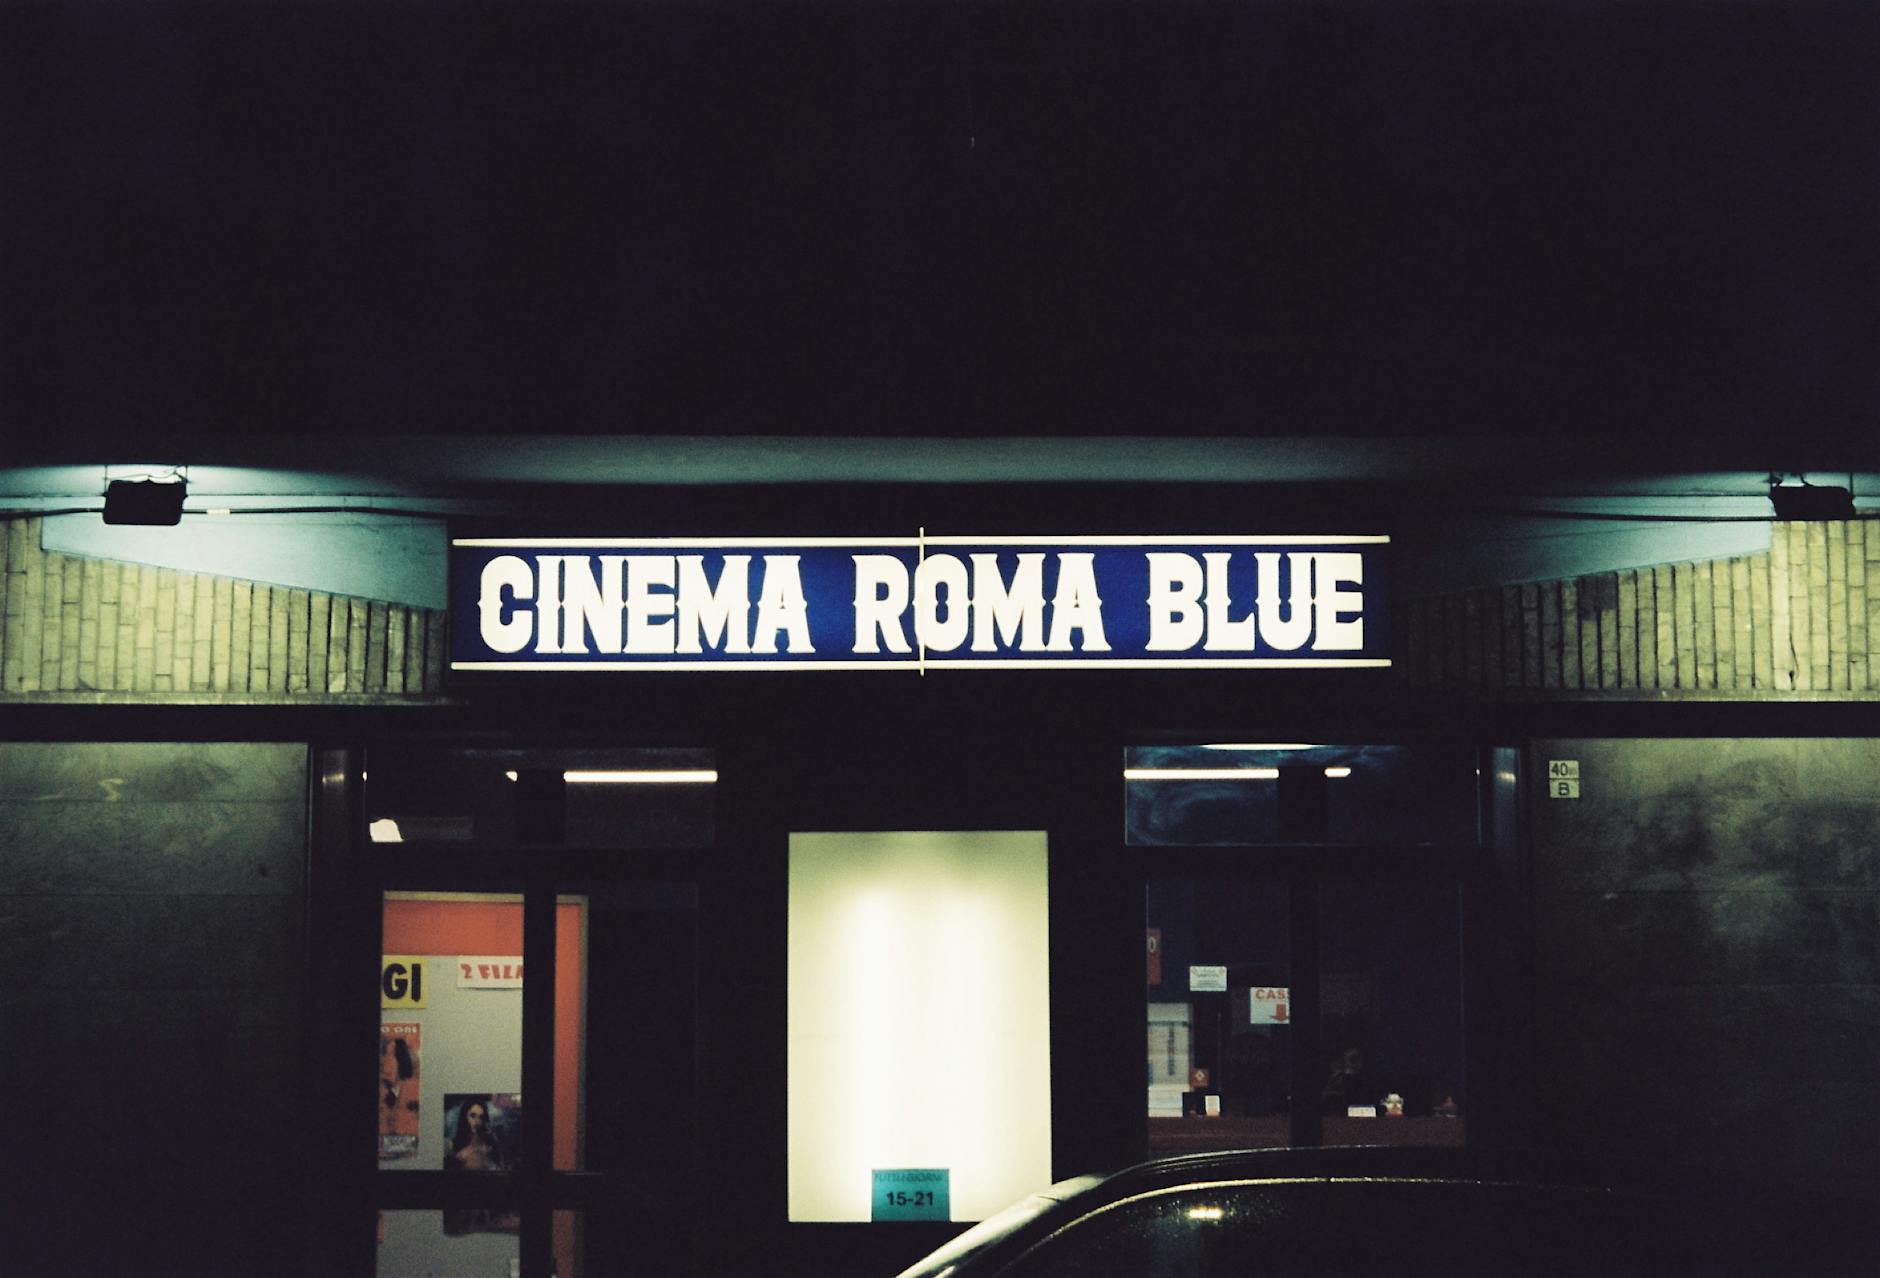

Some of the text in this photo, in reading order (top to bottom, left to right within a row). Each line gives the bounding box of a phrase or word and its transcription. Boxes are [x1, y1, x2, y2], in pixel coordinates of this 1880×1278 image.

[477, 552, 1363, 654] CINEMA ROMA BLUE
[1551, 762, 1568, 776] 40
[1558, 782, 1570, 796] B
[460, 963, 473, 979] 2
[1255, 988, 1290, 1000] CAS
[886, 1191, 934, 1206] 15-21
